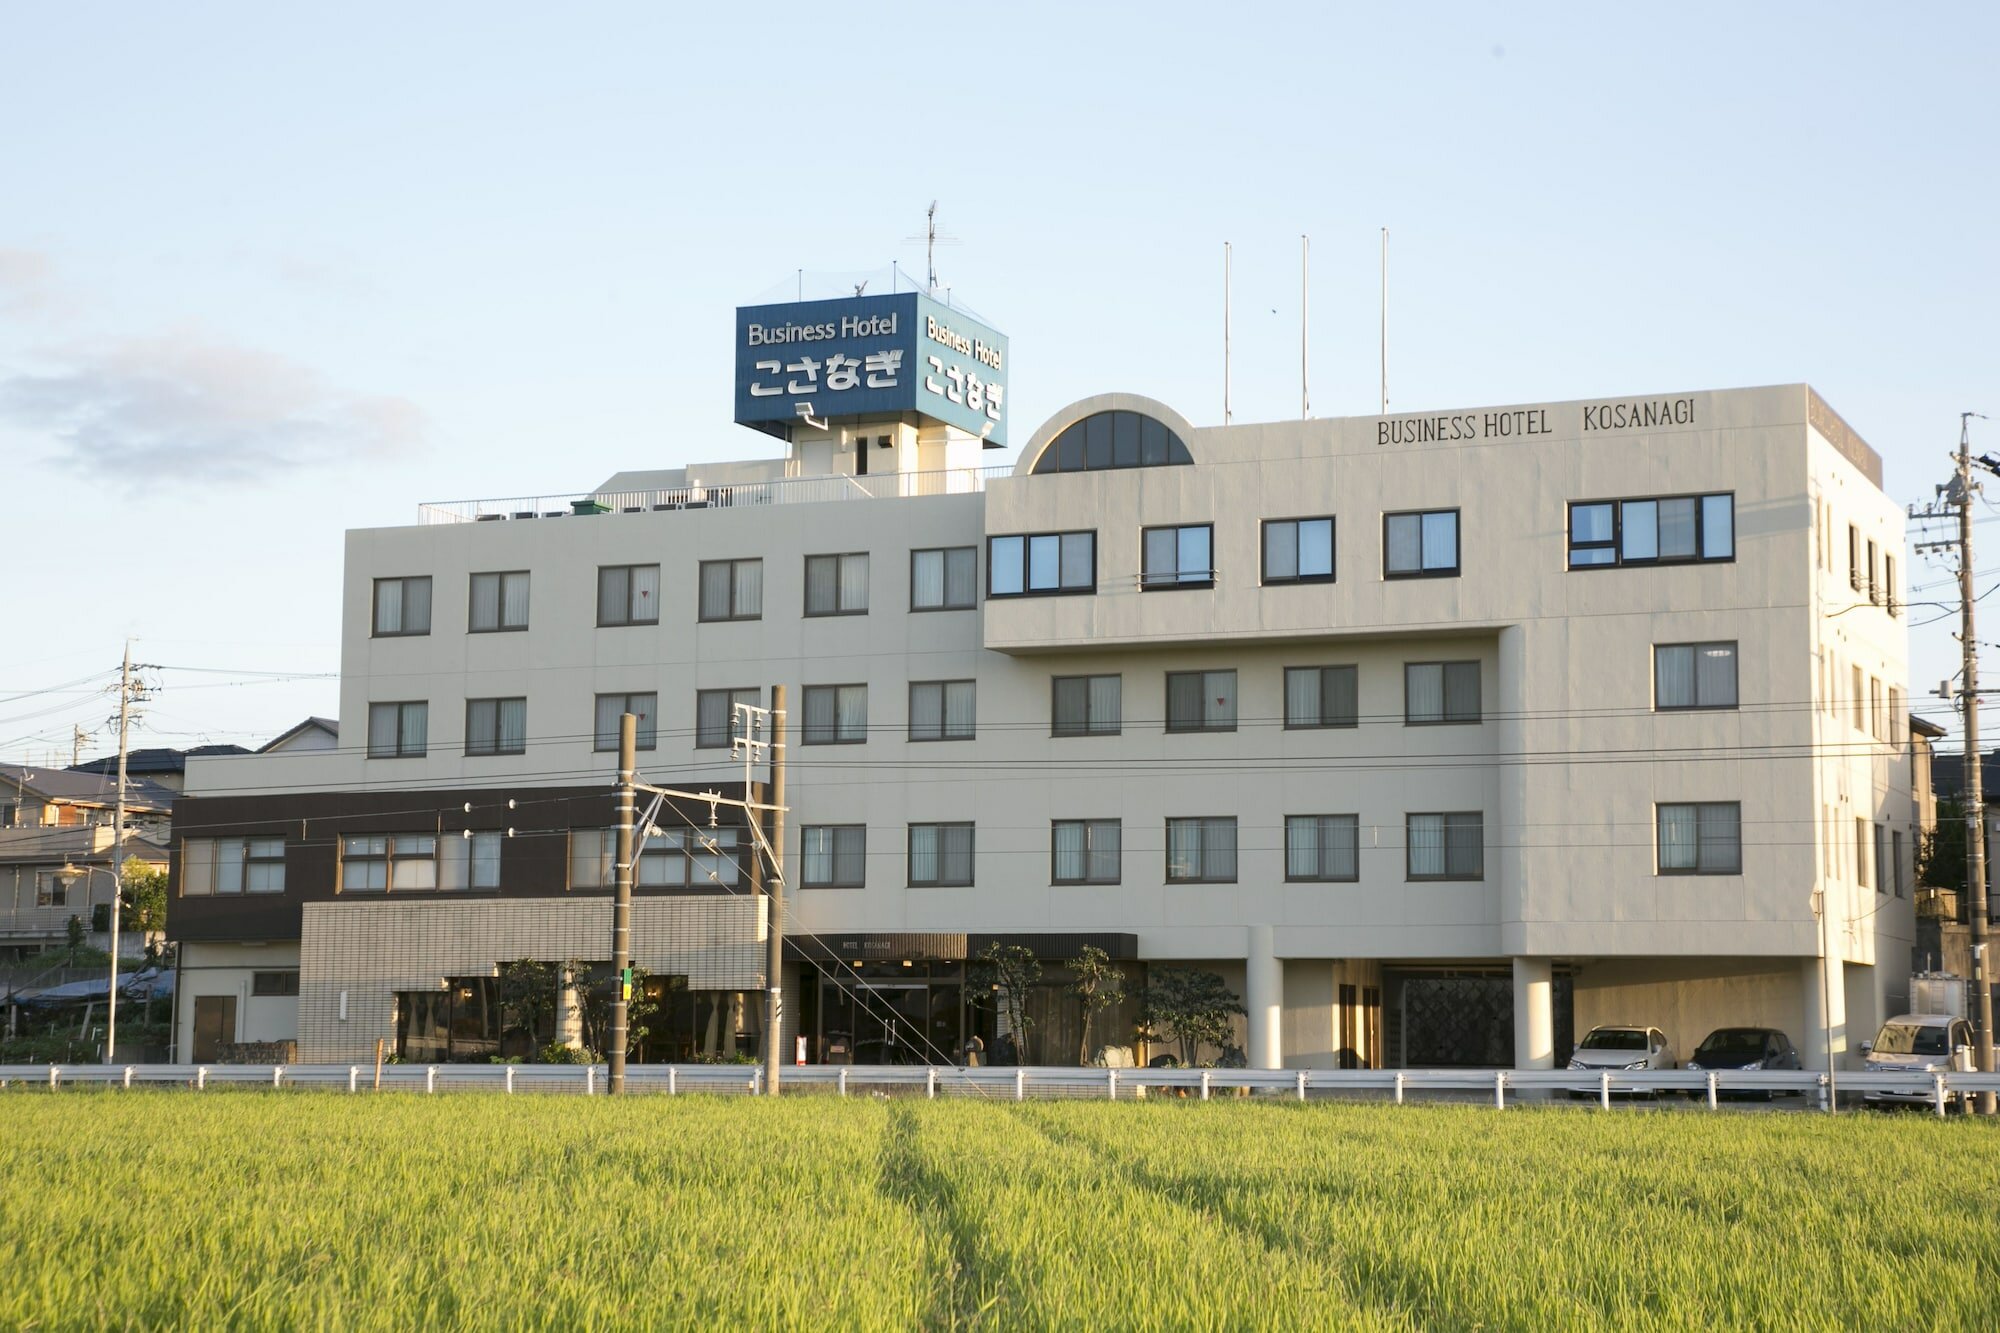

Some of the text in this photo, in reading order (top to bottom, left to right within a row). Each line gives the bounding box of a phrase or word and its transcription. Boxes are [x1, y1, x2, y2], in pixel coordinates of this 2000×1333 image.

[748, 312, 897, 346] Business Hotel
[926, 314, 1002, 371] Business Hotel
[750, 349, 904, 397] こさなぎ
[925, 355, 1004, 421] こさなぎ
[1377, 398, 1695, 445] BUSINESS HOTEL KOSANAGI
